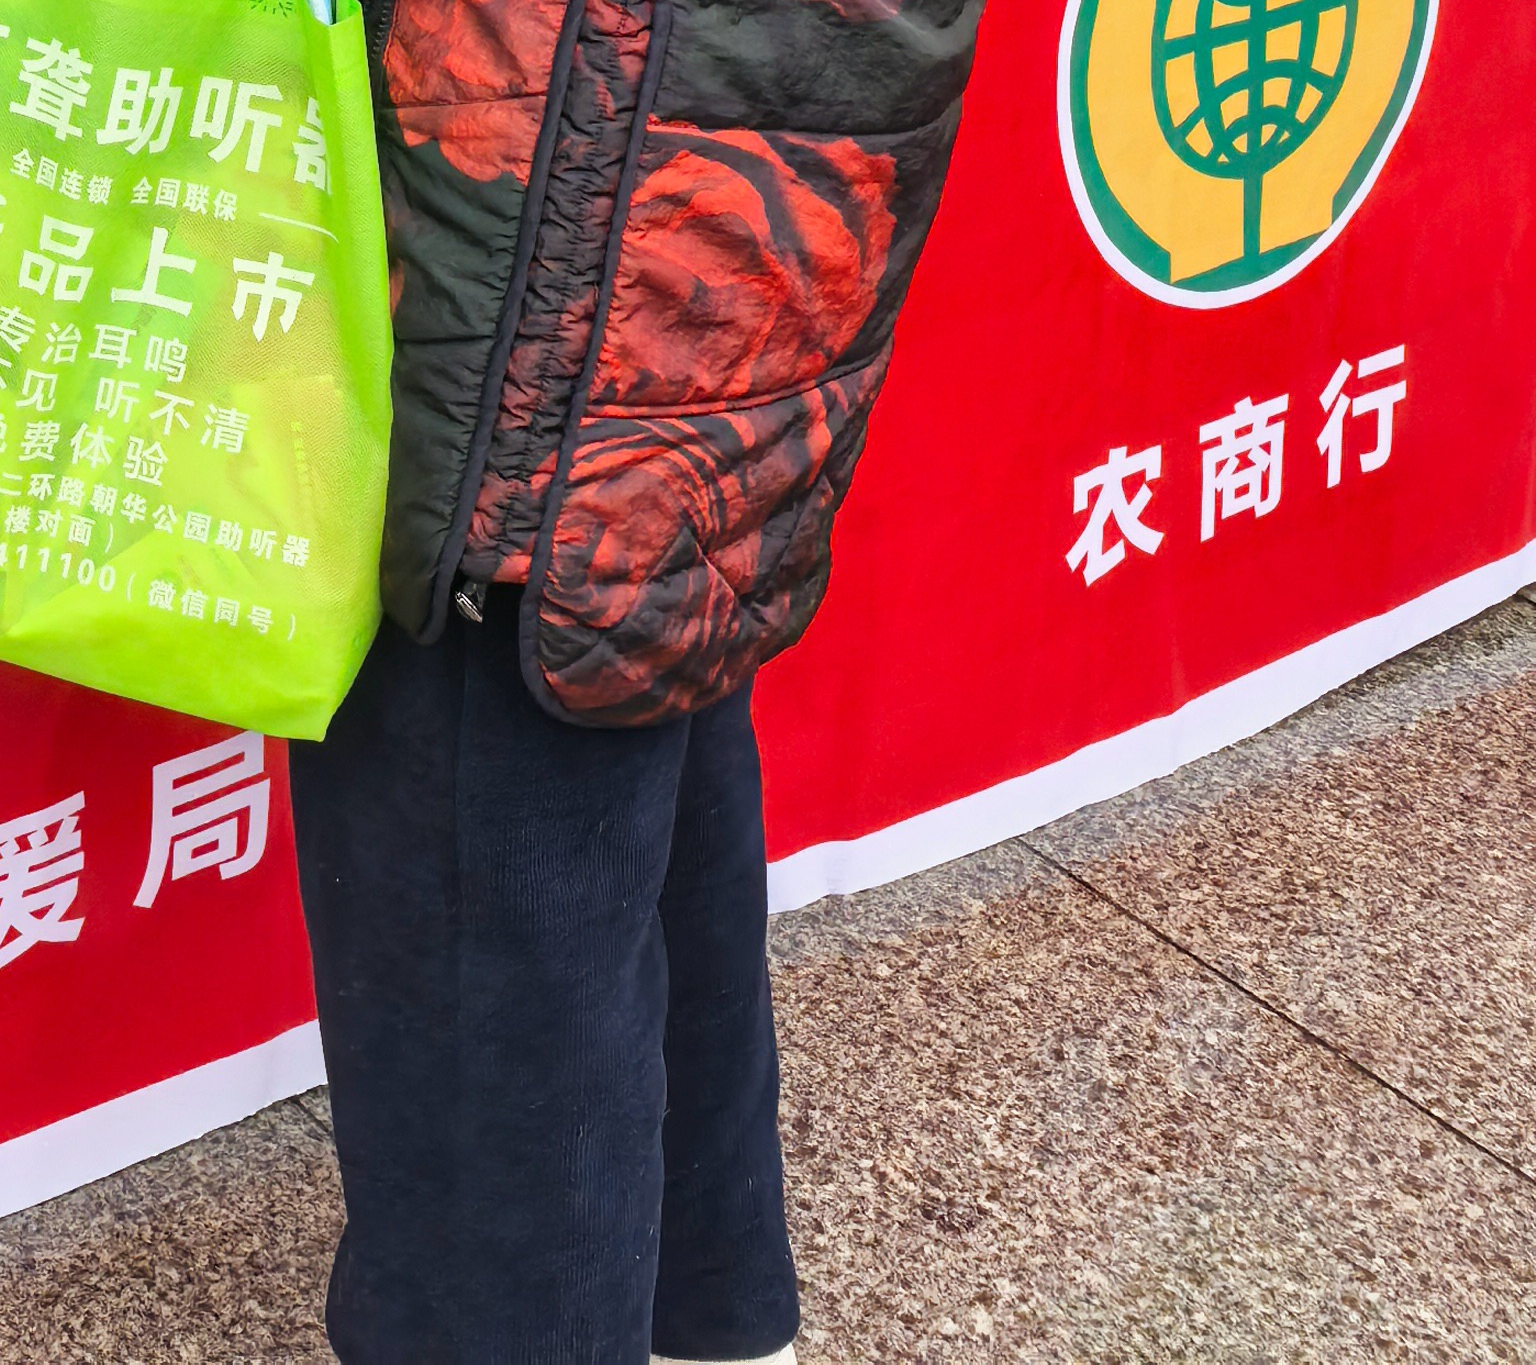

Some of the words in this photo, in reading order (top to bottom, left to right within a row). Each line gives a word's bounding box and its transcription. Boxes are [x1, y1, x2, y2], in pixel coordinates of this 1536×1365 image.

[11, 149, 113, 205] 全国连锁
[131, 176, 238, 222] 全国联保
[94, 378, 249, 454] 听不清
[1065, 343, 1408, 588] 农商行
